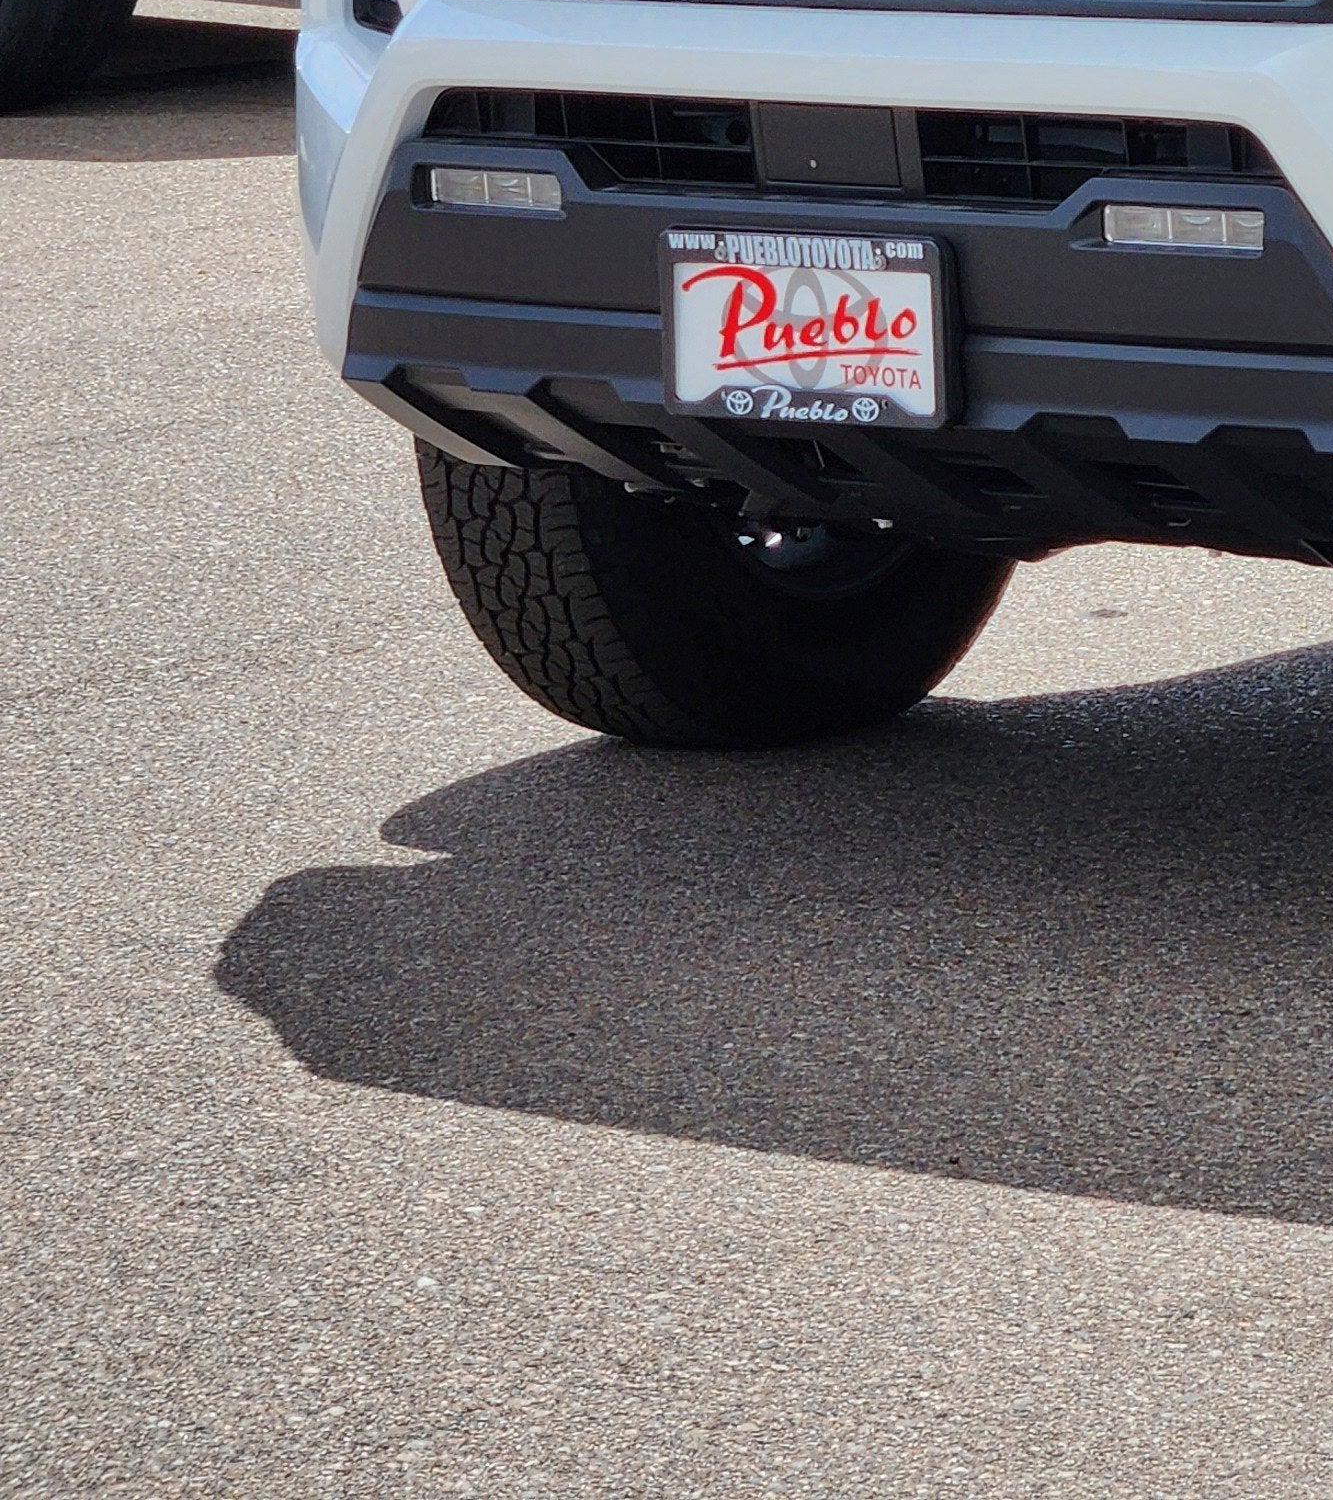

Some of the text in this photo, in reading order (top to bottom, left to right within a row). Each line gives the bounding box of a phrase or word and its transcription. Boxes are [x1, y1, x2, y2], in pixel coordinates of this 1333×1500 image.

[681, 264, 918, 358] Pueblo
[840, 364, 922, 390] TOYOTA
[751, 385, 849, 422] Pueblo
